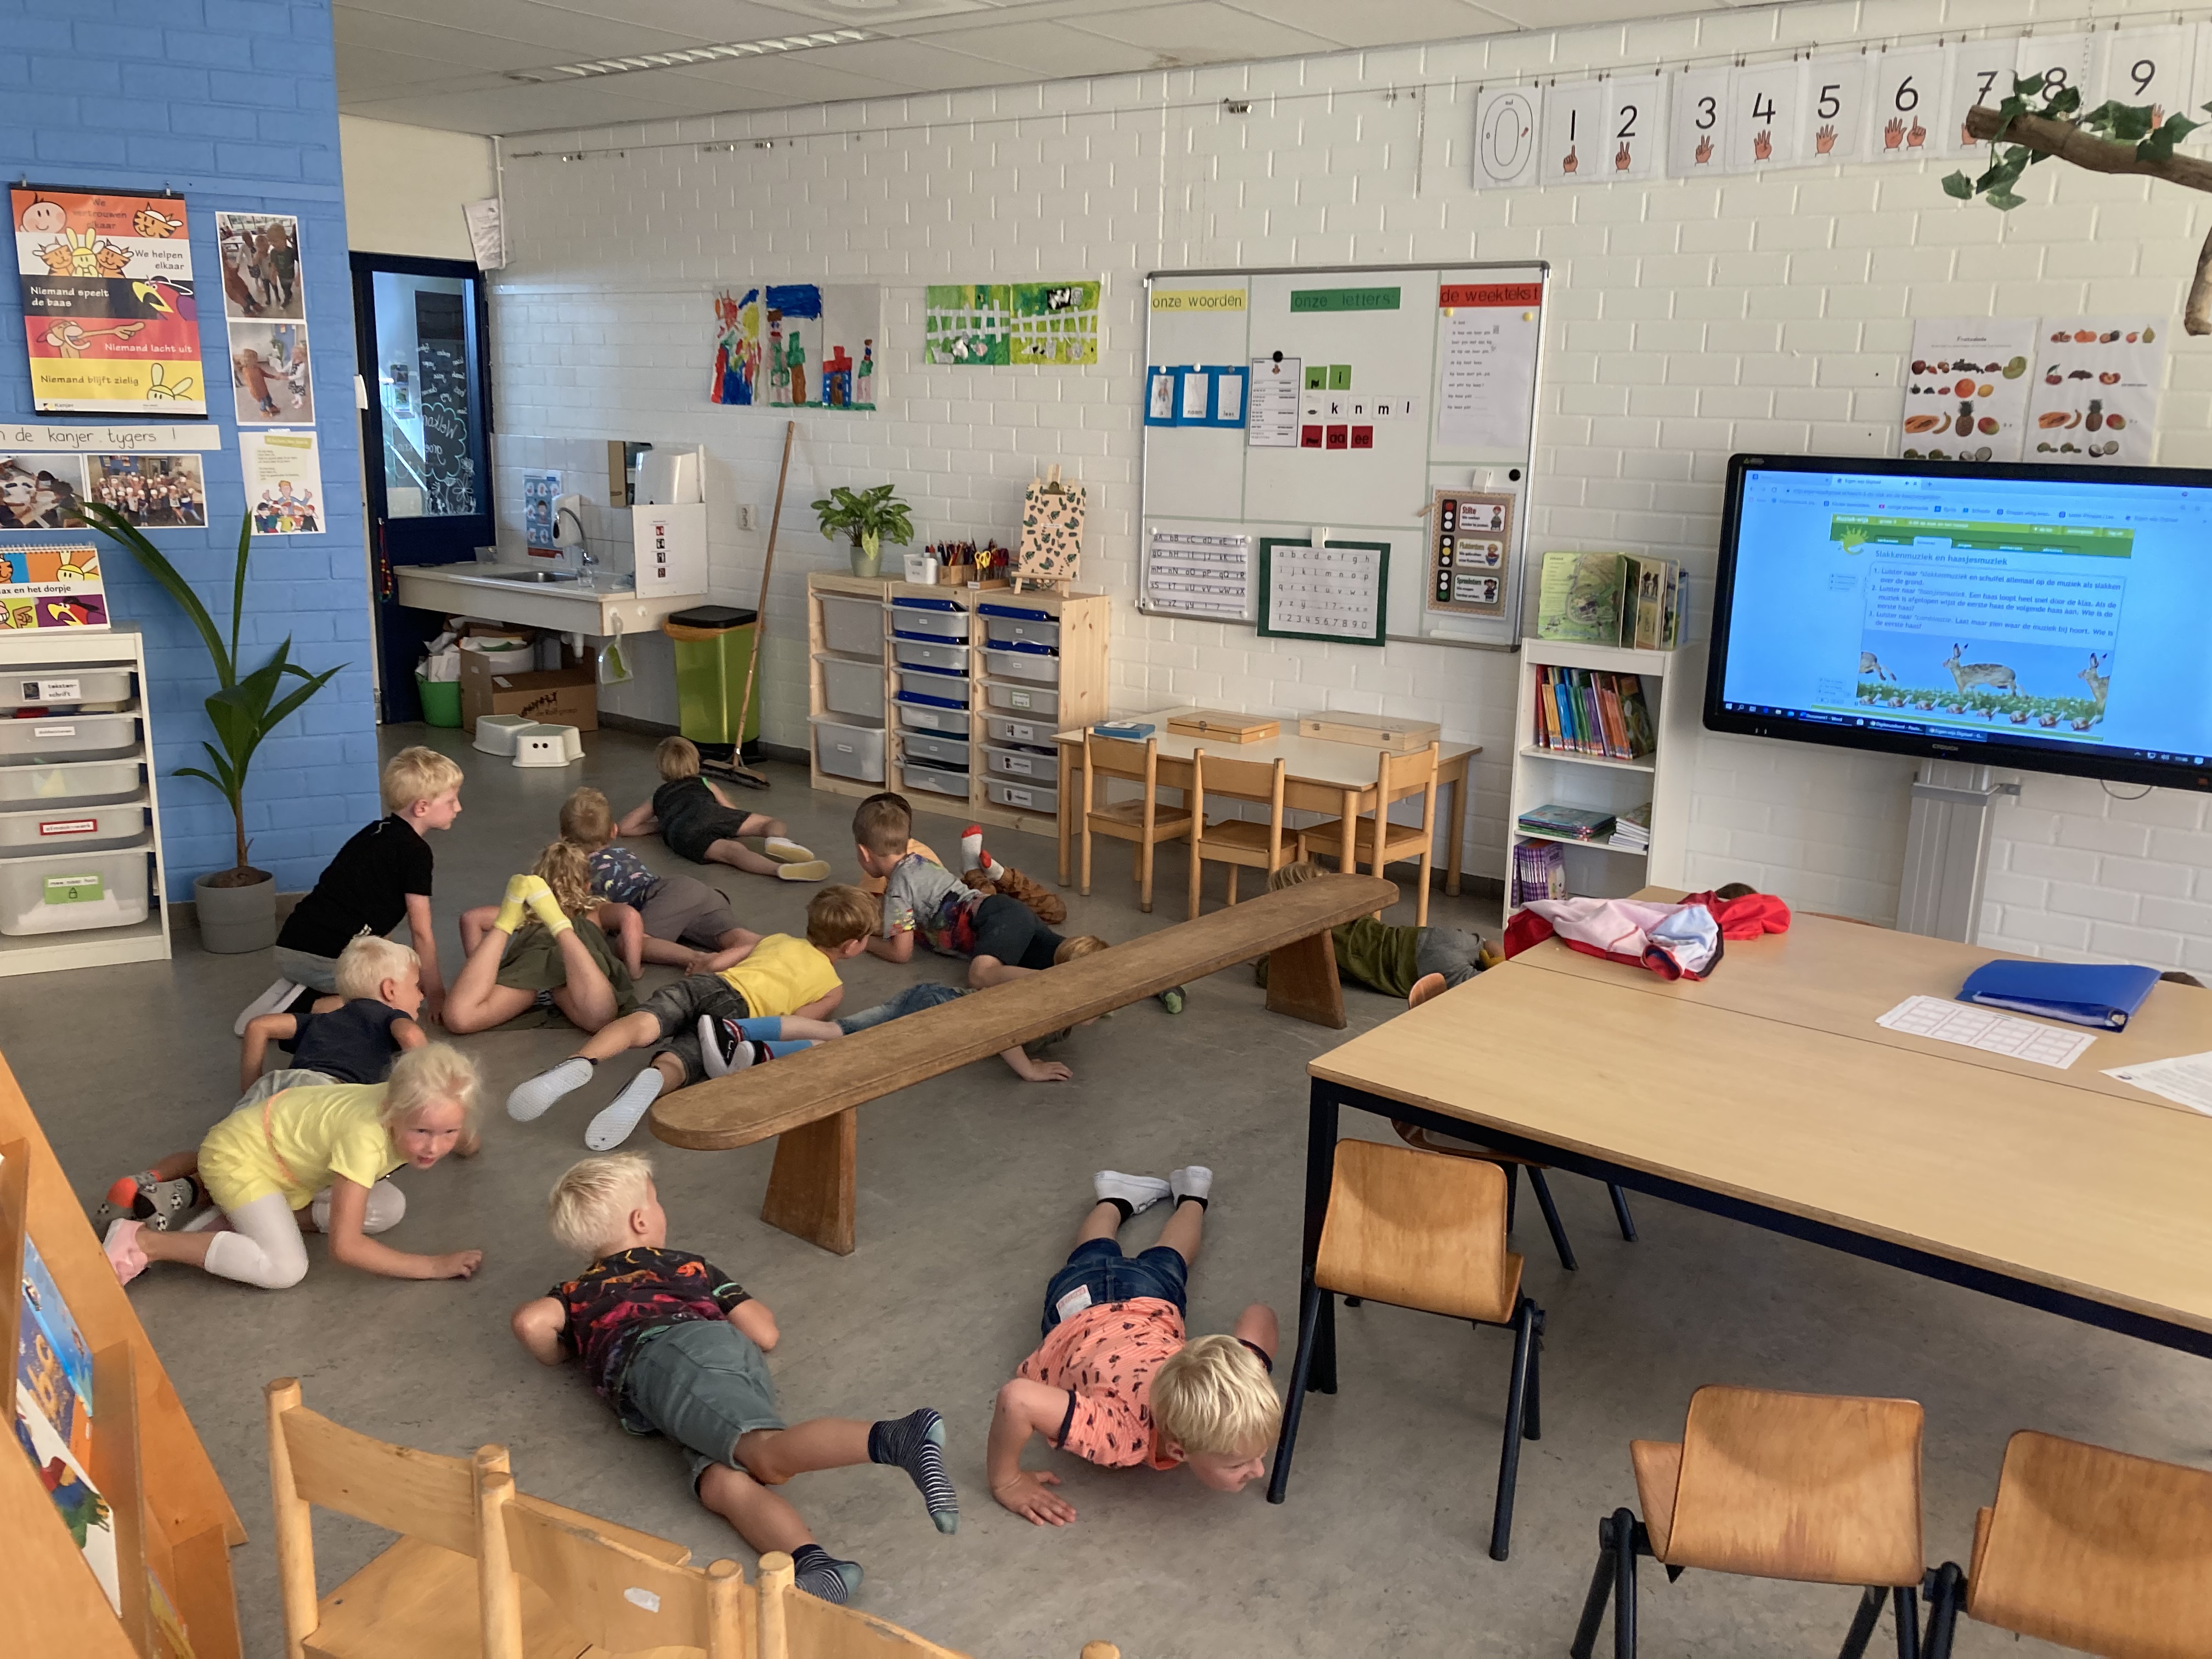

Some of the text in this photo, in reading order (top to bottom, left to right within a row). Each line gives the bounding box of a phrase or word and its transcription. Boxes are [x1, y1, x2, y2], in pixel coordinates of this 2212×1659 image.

[2130, 59, 2155, 97] 9
[1976, 70, 1998, 107] 7
[2042, 66, 2068, 105] 8
[1895, 76, 1919, 111] 6
[1752, 92, 1776, 125] 4
[1817, 84, 1841, 119] 5
[1695, 96, 1717, 129] 3
[1570, 109, 1576, 142] 1
[1616, 105, 1638, 139] 2
[136, 250, 183, 259] We helpen
[155, 262, 185, 270] elkaar
[30, 286, 109, 298] Niemand speelt
[1441, 289, 1459, 303] de
[31, 298, 44, 307] de
[1153, 294, 1242, 308] onze woorden
[1294, 293, 1390, 308] onze letters
[105, 343, 148, 353] Niemand
[151, 343, 176, 352] lacht
[41, 375, 139, 386] Niemand blijft zielig
[1331, 402, 1339, 414] k
[1355, 405, 1363, 415] n
[1378, 404, 1390, 415] m
[15, 427, 34, 442] de
[47, 427, 94, 449] kanjer
[108, 428, 157, 449] tygers
[172, 427, 176, 440] !
[1329, 433, 1346, 444] aa
[1354, 435, 1369, 445] ee
[1875, 550, 1933, 561] Slakkenmuziek
[1948, 554, 2007, 565] haasjesmuziek
[27, 585, 42, 594] het
[44, 584, 71, 594] dorpje
